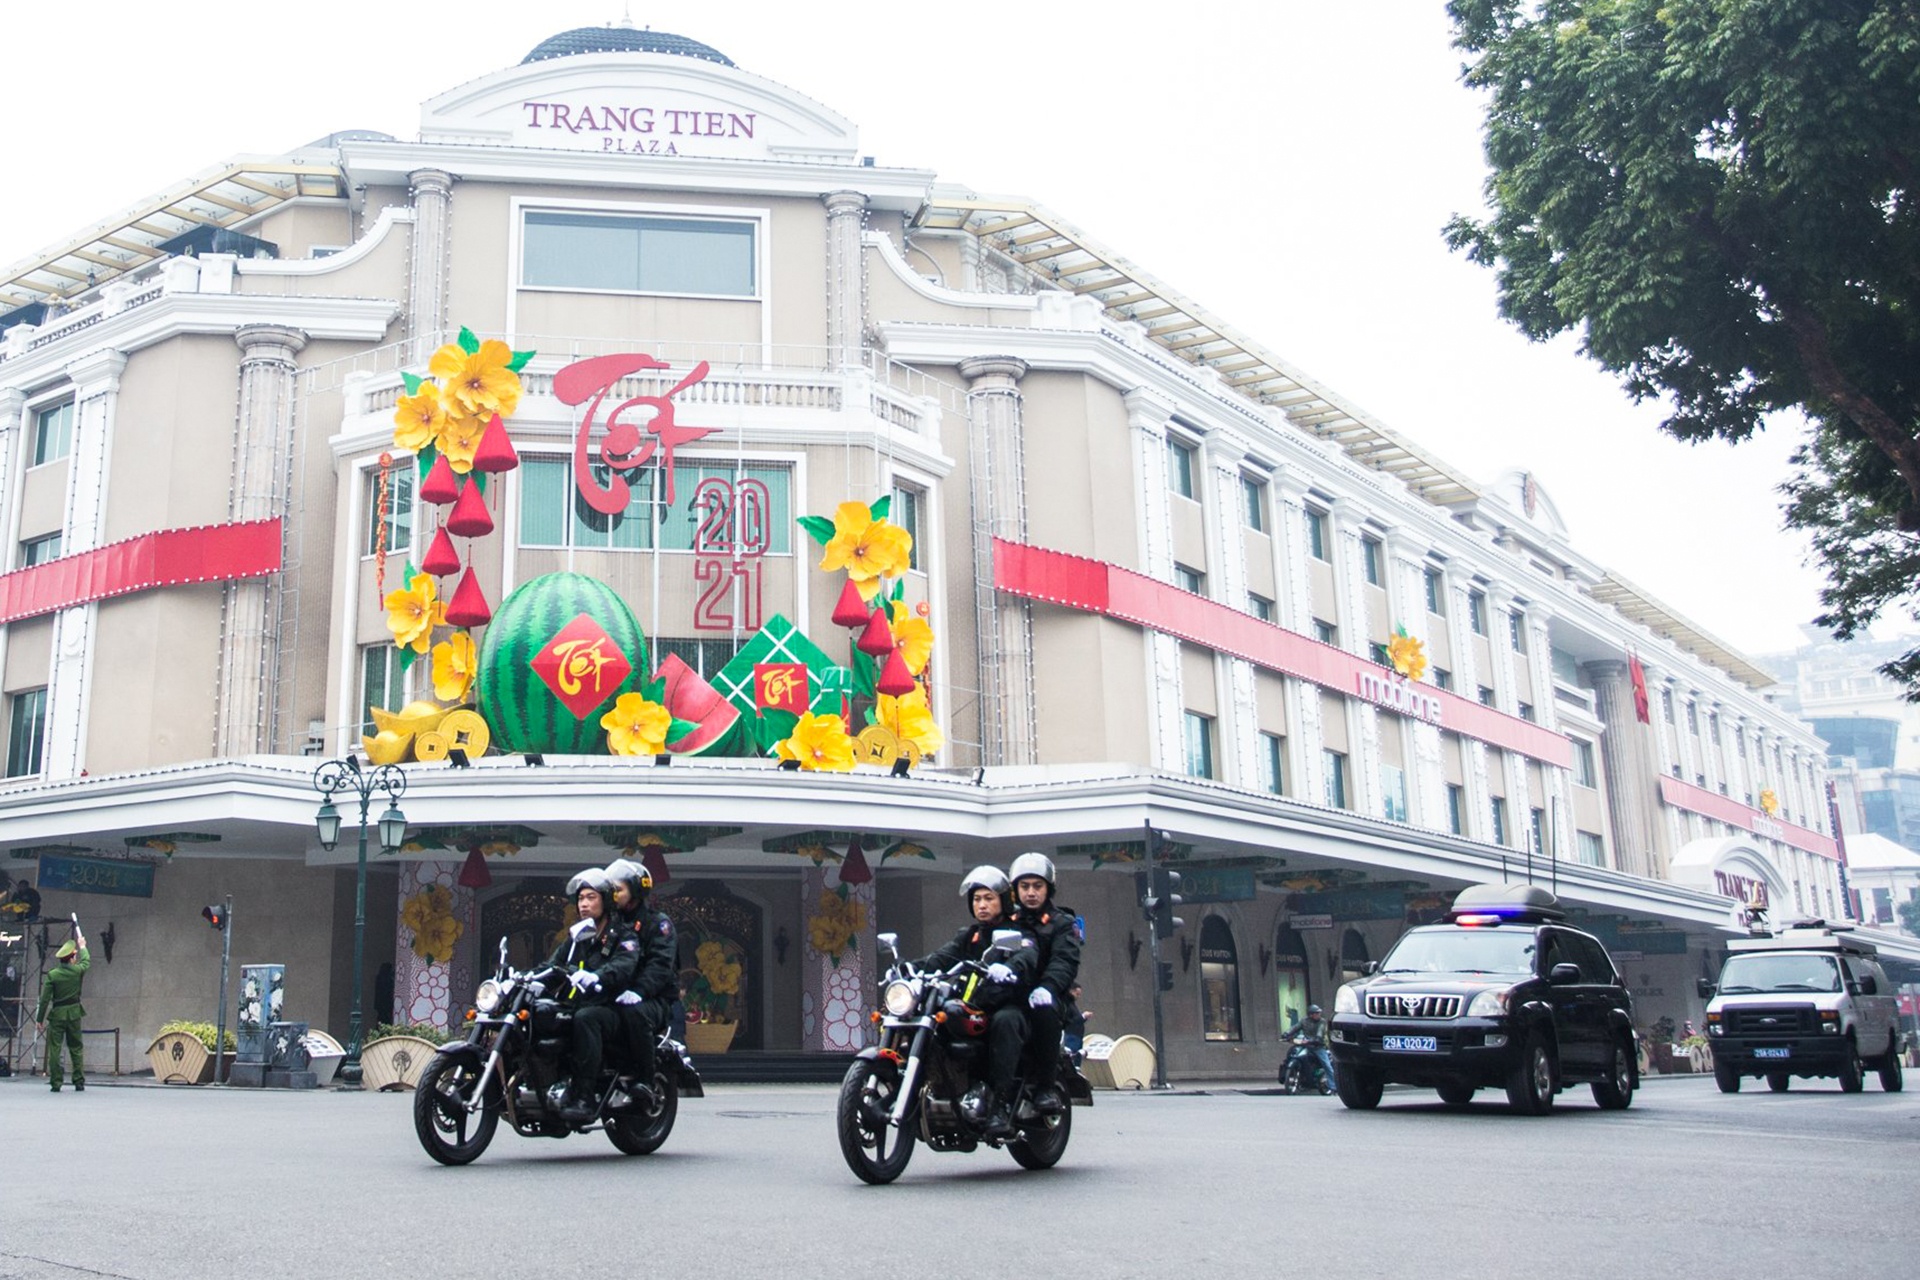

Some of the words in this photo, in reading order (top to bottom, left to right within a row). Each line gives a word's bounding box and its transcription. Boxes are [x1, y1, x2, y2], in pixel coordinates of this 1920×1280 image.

[523, 102, 655, 133] TRANG
[664, 109, 757, 139] TIEN
[602, 137, 678, 154] PLAZA
[695, 477, 771, 558] 20
[694, 559, 762, 631] 21
[1714, 869, 1749, 904] TRANG
[1747, 878, 1770, 908] TEN
